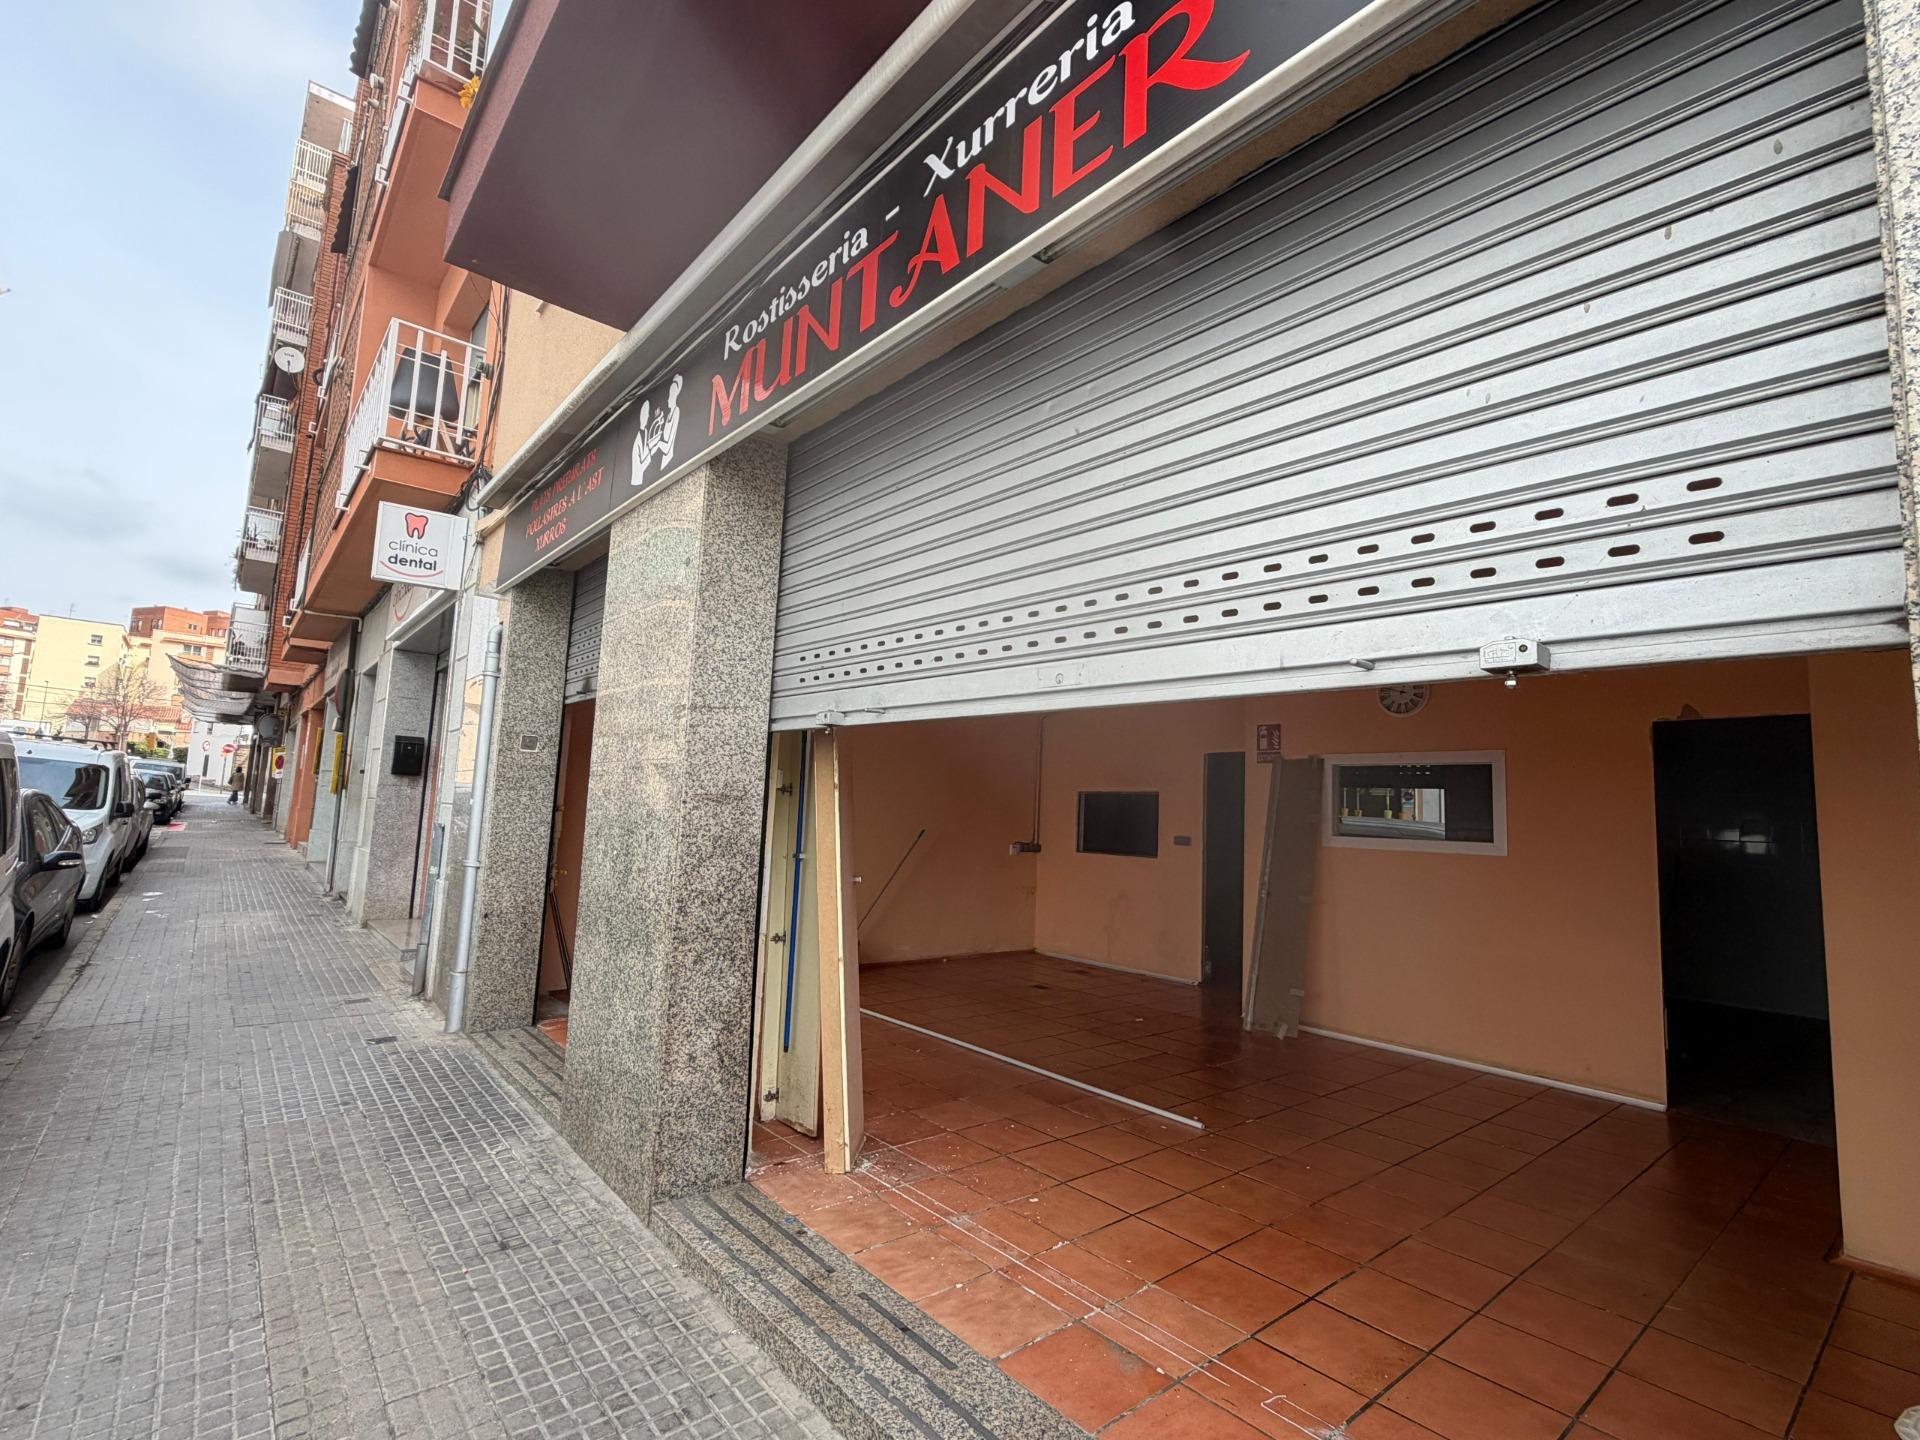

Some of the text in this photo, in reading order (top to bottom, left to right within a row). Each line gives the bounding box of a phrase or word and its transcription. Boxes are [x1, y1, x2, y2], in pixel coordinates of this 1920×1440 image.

[708, 0, 1250, 436] MUNTANER
[724, 227, 868, 360] Rostisseria
[923, 1, 1136, 197] Xurreria
[387, 553, 437, 571] dental
[388, 539, 438, 557] clínica
